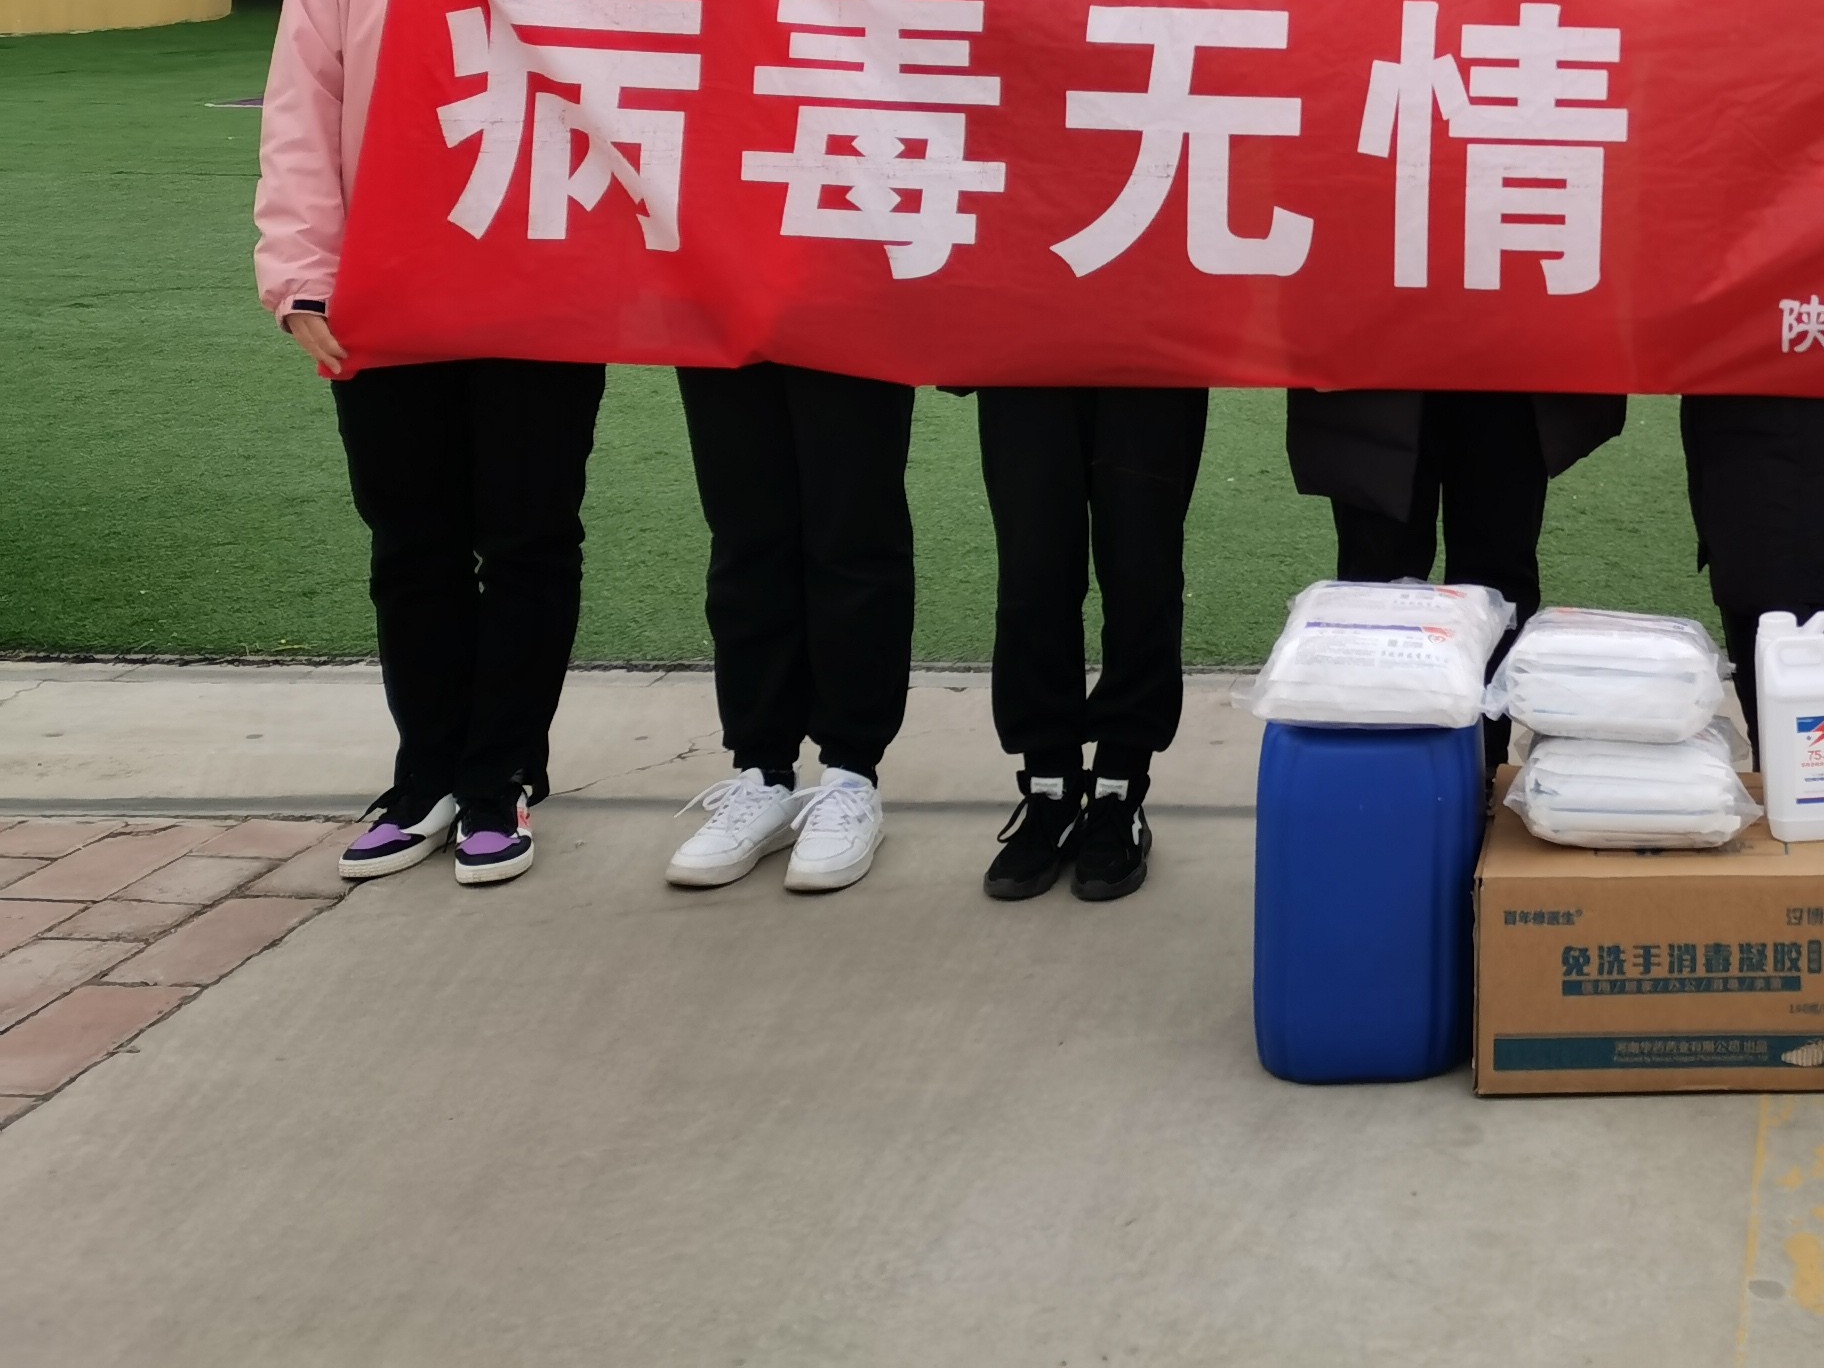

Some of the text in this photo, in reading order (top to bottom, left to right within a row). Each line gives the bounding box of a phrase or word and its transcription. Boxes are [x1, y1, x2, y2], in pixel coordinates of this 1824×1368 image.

[1561, 943, 1802, 977] 免洗手消毒凝胶
